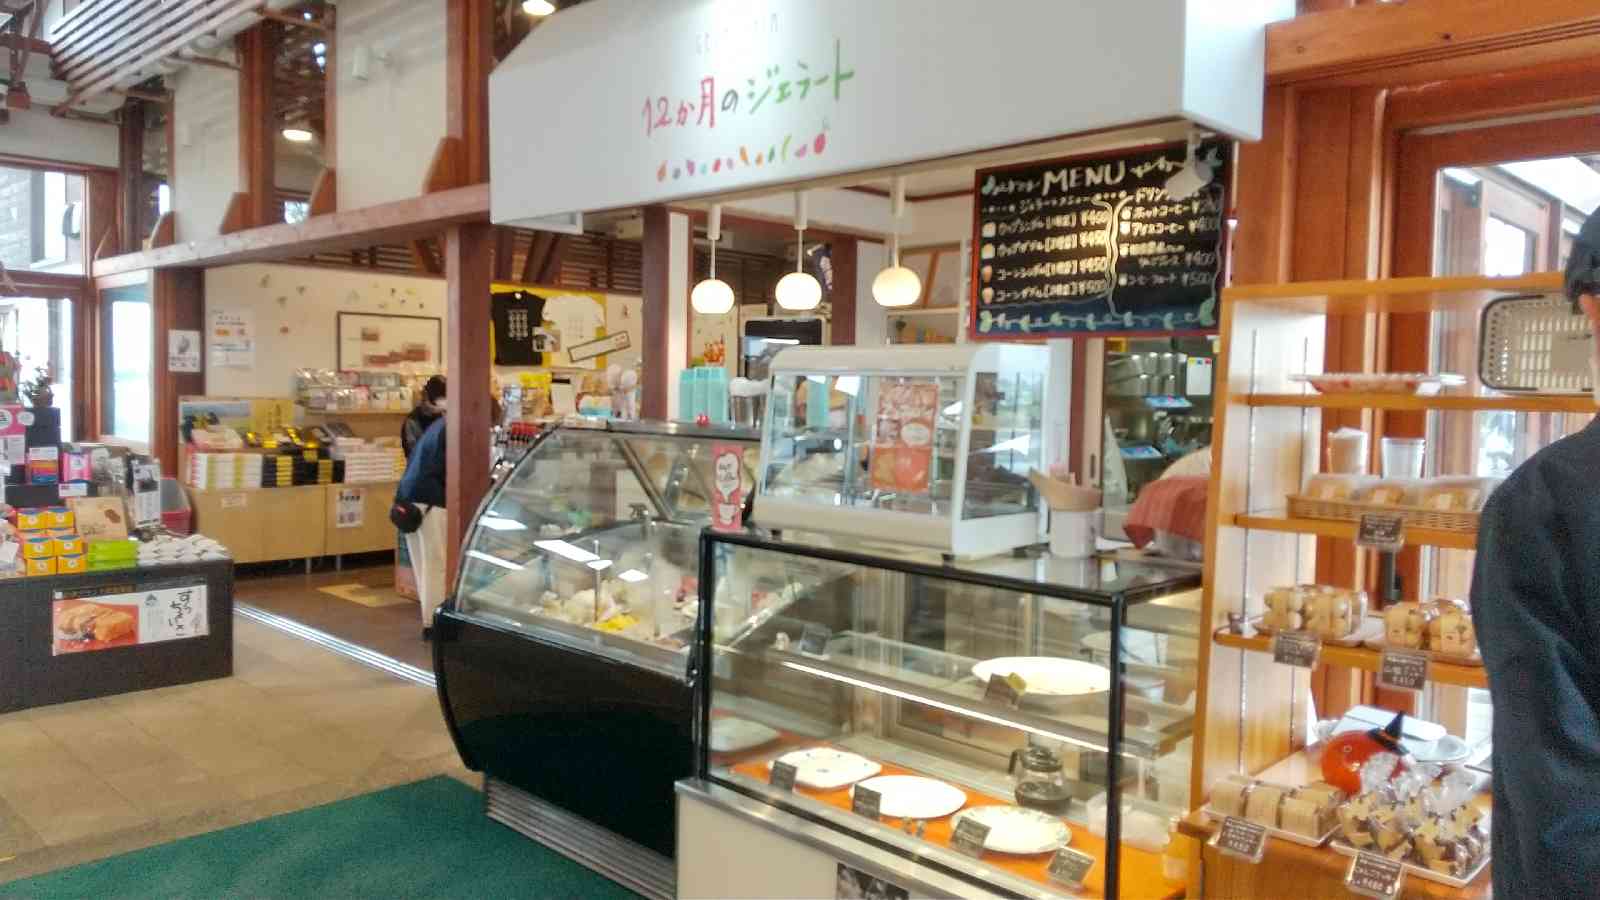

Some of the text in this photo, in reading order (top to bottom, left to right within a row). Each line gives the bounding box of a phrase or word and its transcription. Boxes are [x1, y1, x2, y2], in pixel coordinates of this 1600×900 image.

[642, 37, 855, 138] 12か月のジェラート
[1042, 160, 1126, 195] MENU
